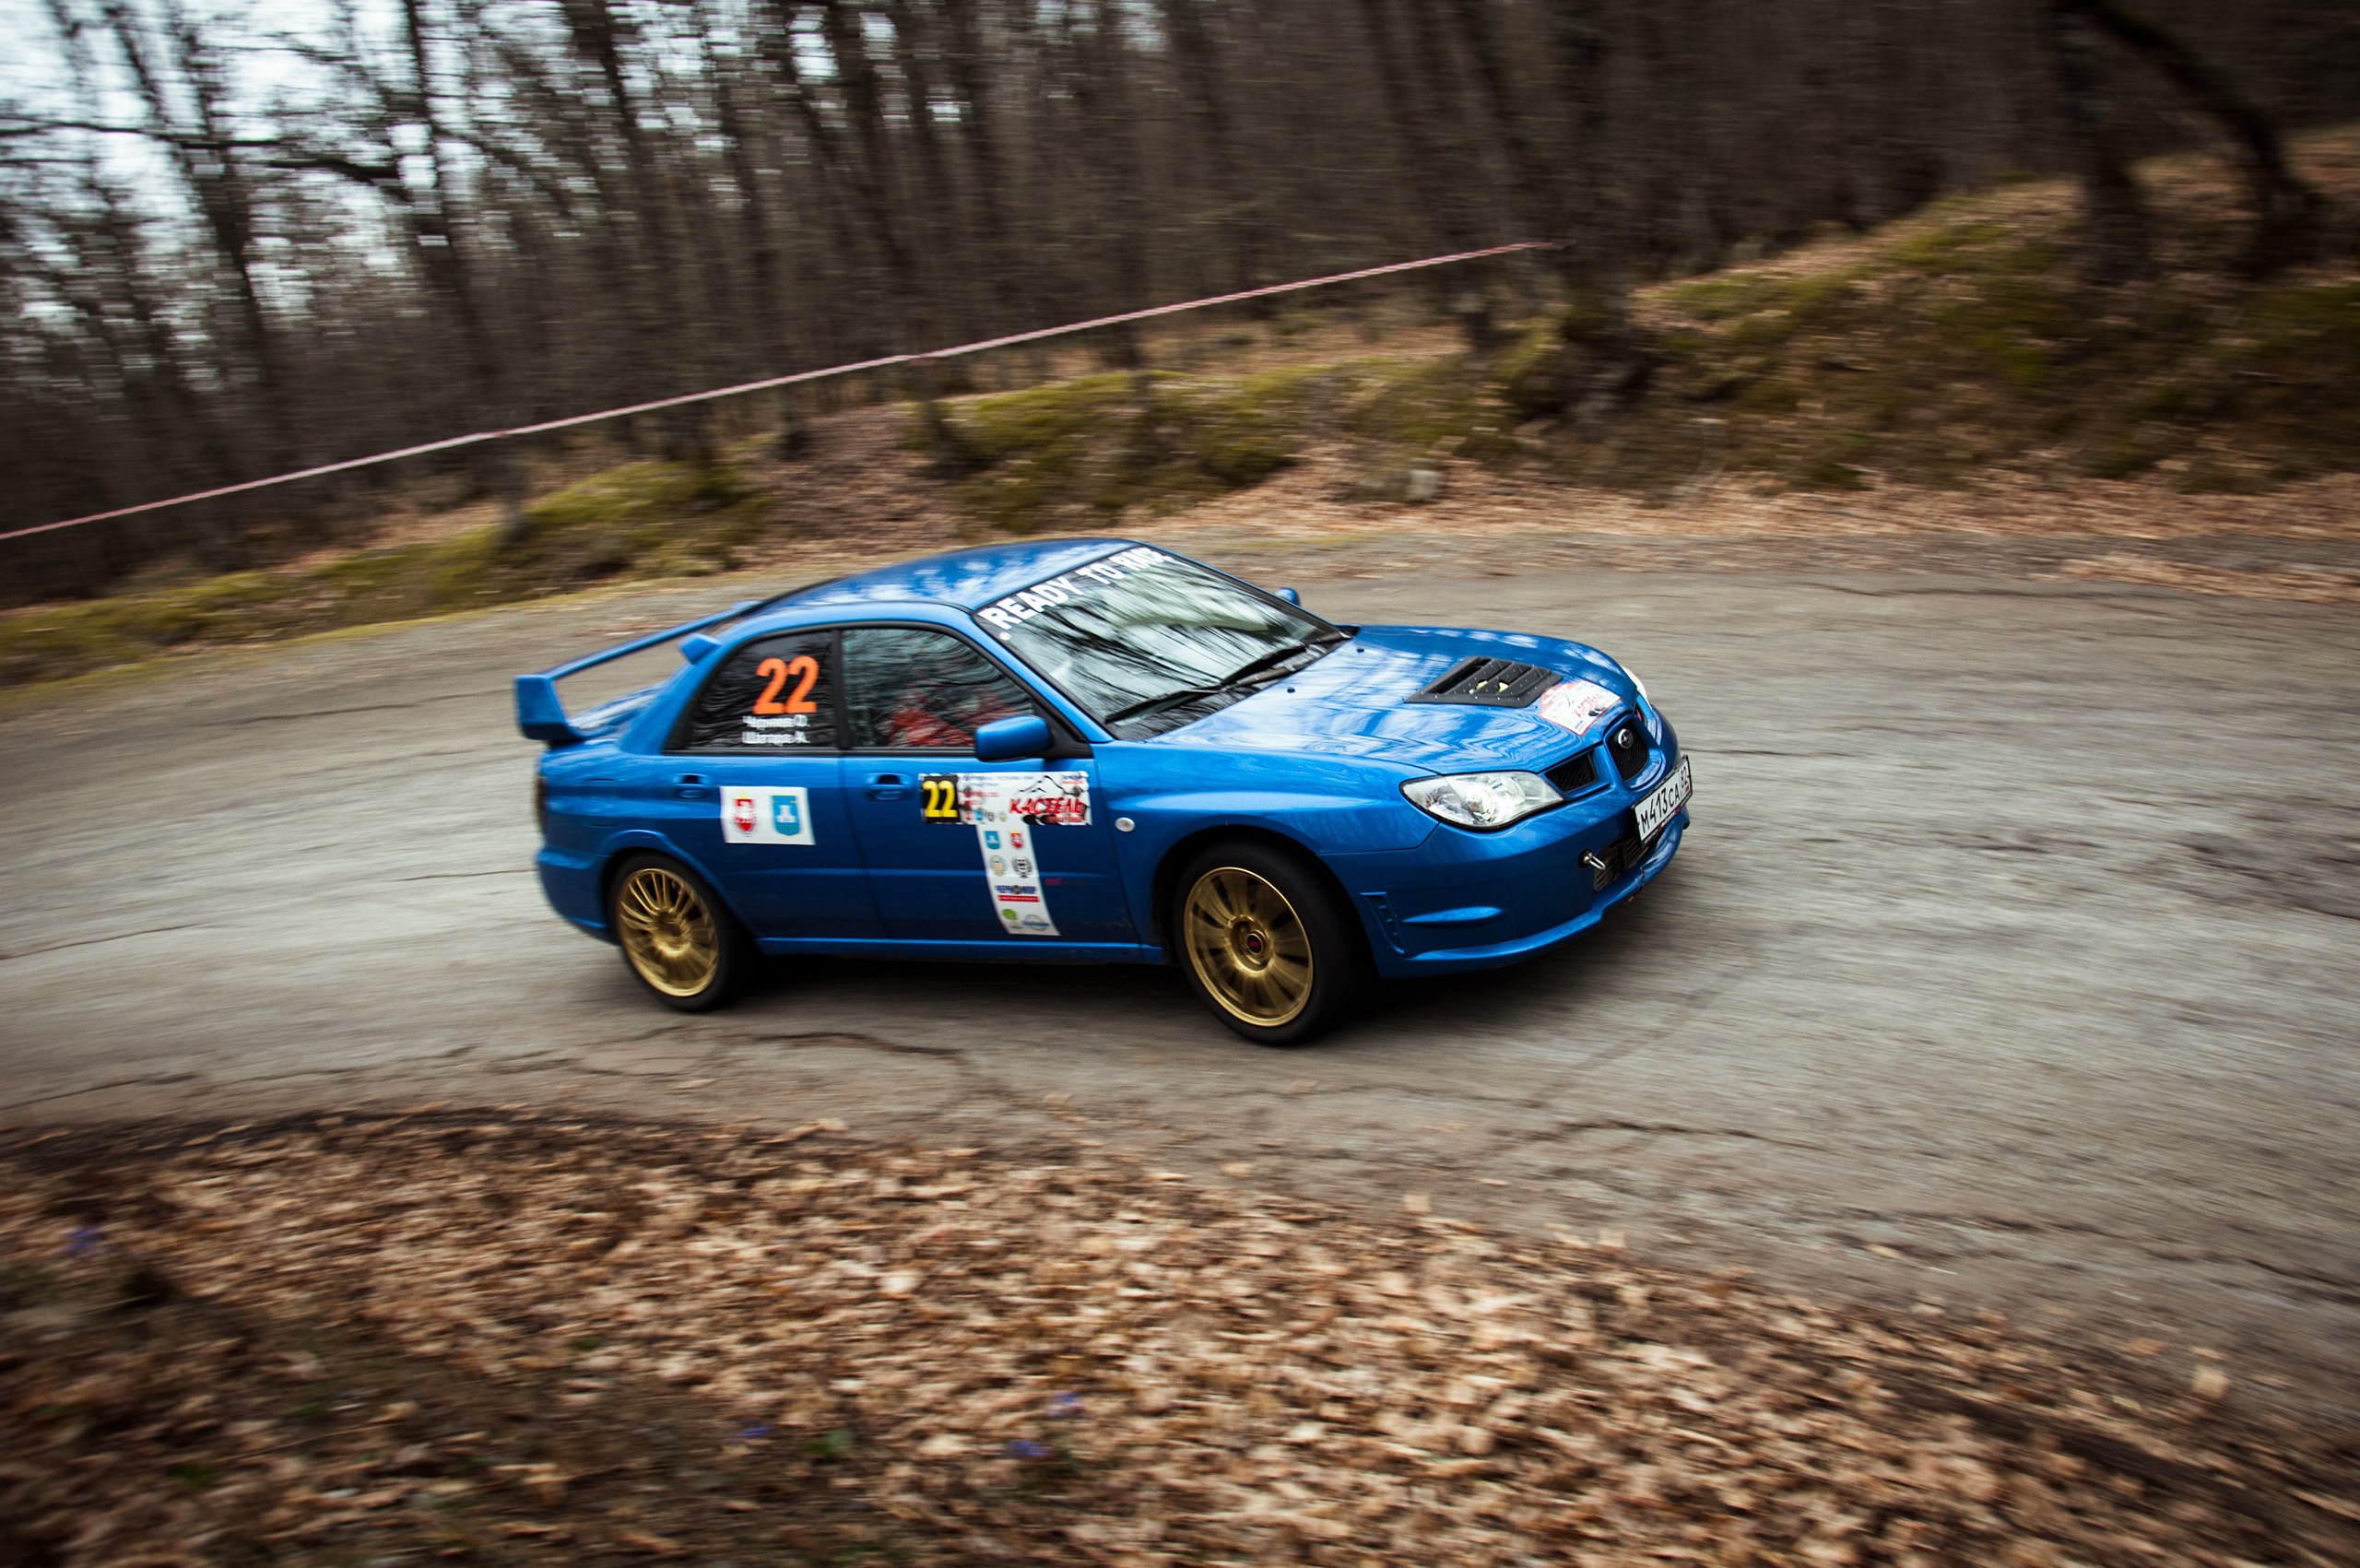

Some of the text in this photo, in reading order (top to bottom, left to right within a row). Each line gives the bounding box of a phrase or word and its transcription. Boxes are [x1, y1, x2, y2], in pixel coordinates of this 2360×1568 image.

[977, 576, 1084, 631] READY
[1075, 562, 1126, 585] TO
[752, 655, 820, 714] 22
[922, 780, 959, 818] 22
